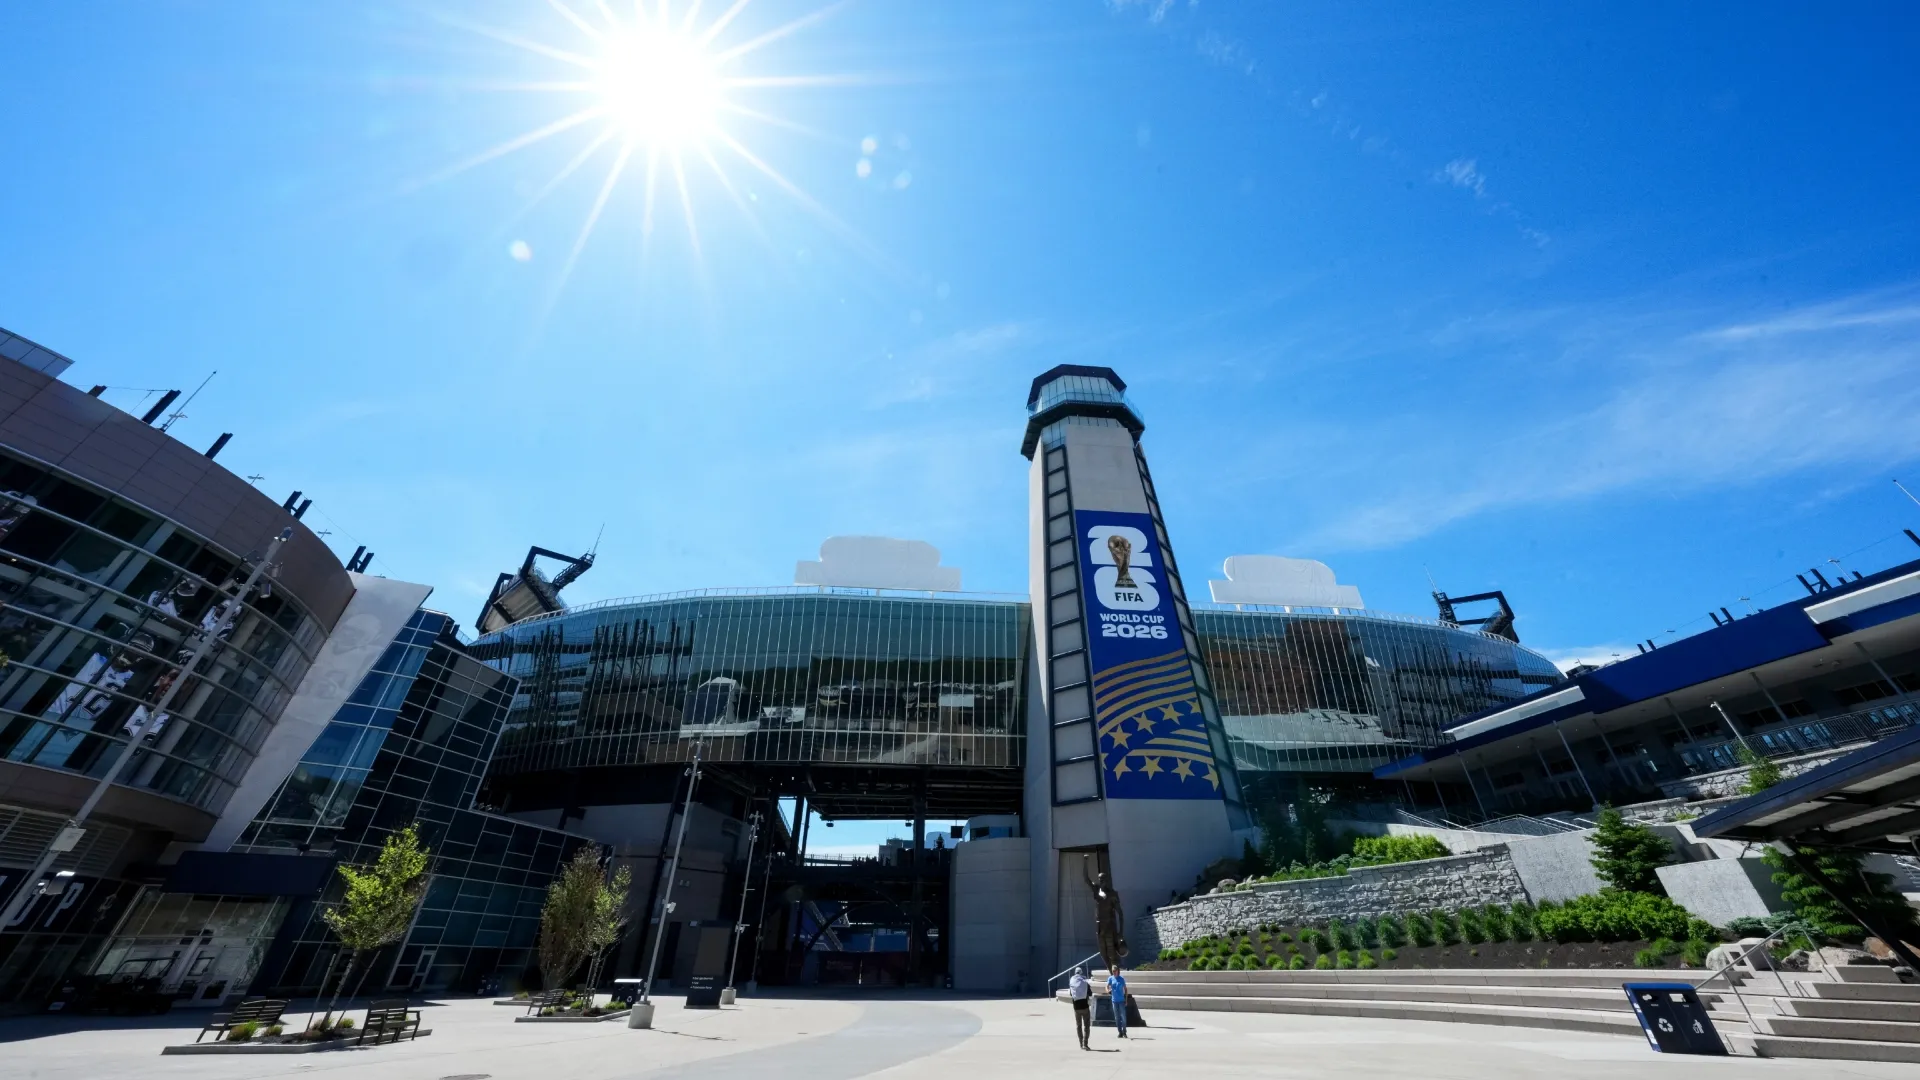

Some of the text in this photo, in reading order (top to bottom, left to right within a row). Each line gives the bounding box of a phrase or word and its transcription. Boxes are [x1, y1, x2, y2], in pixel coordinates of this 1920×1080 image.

[1114, 592, 1144, 602] FIFA
[1099, 613, 1164, 623] WORLD CUP
[1101, 623, 1168, 639] 2026
